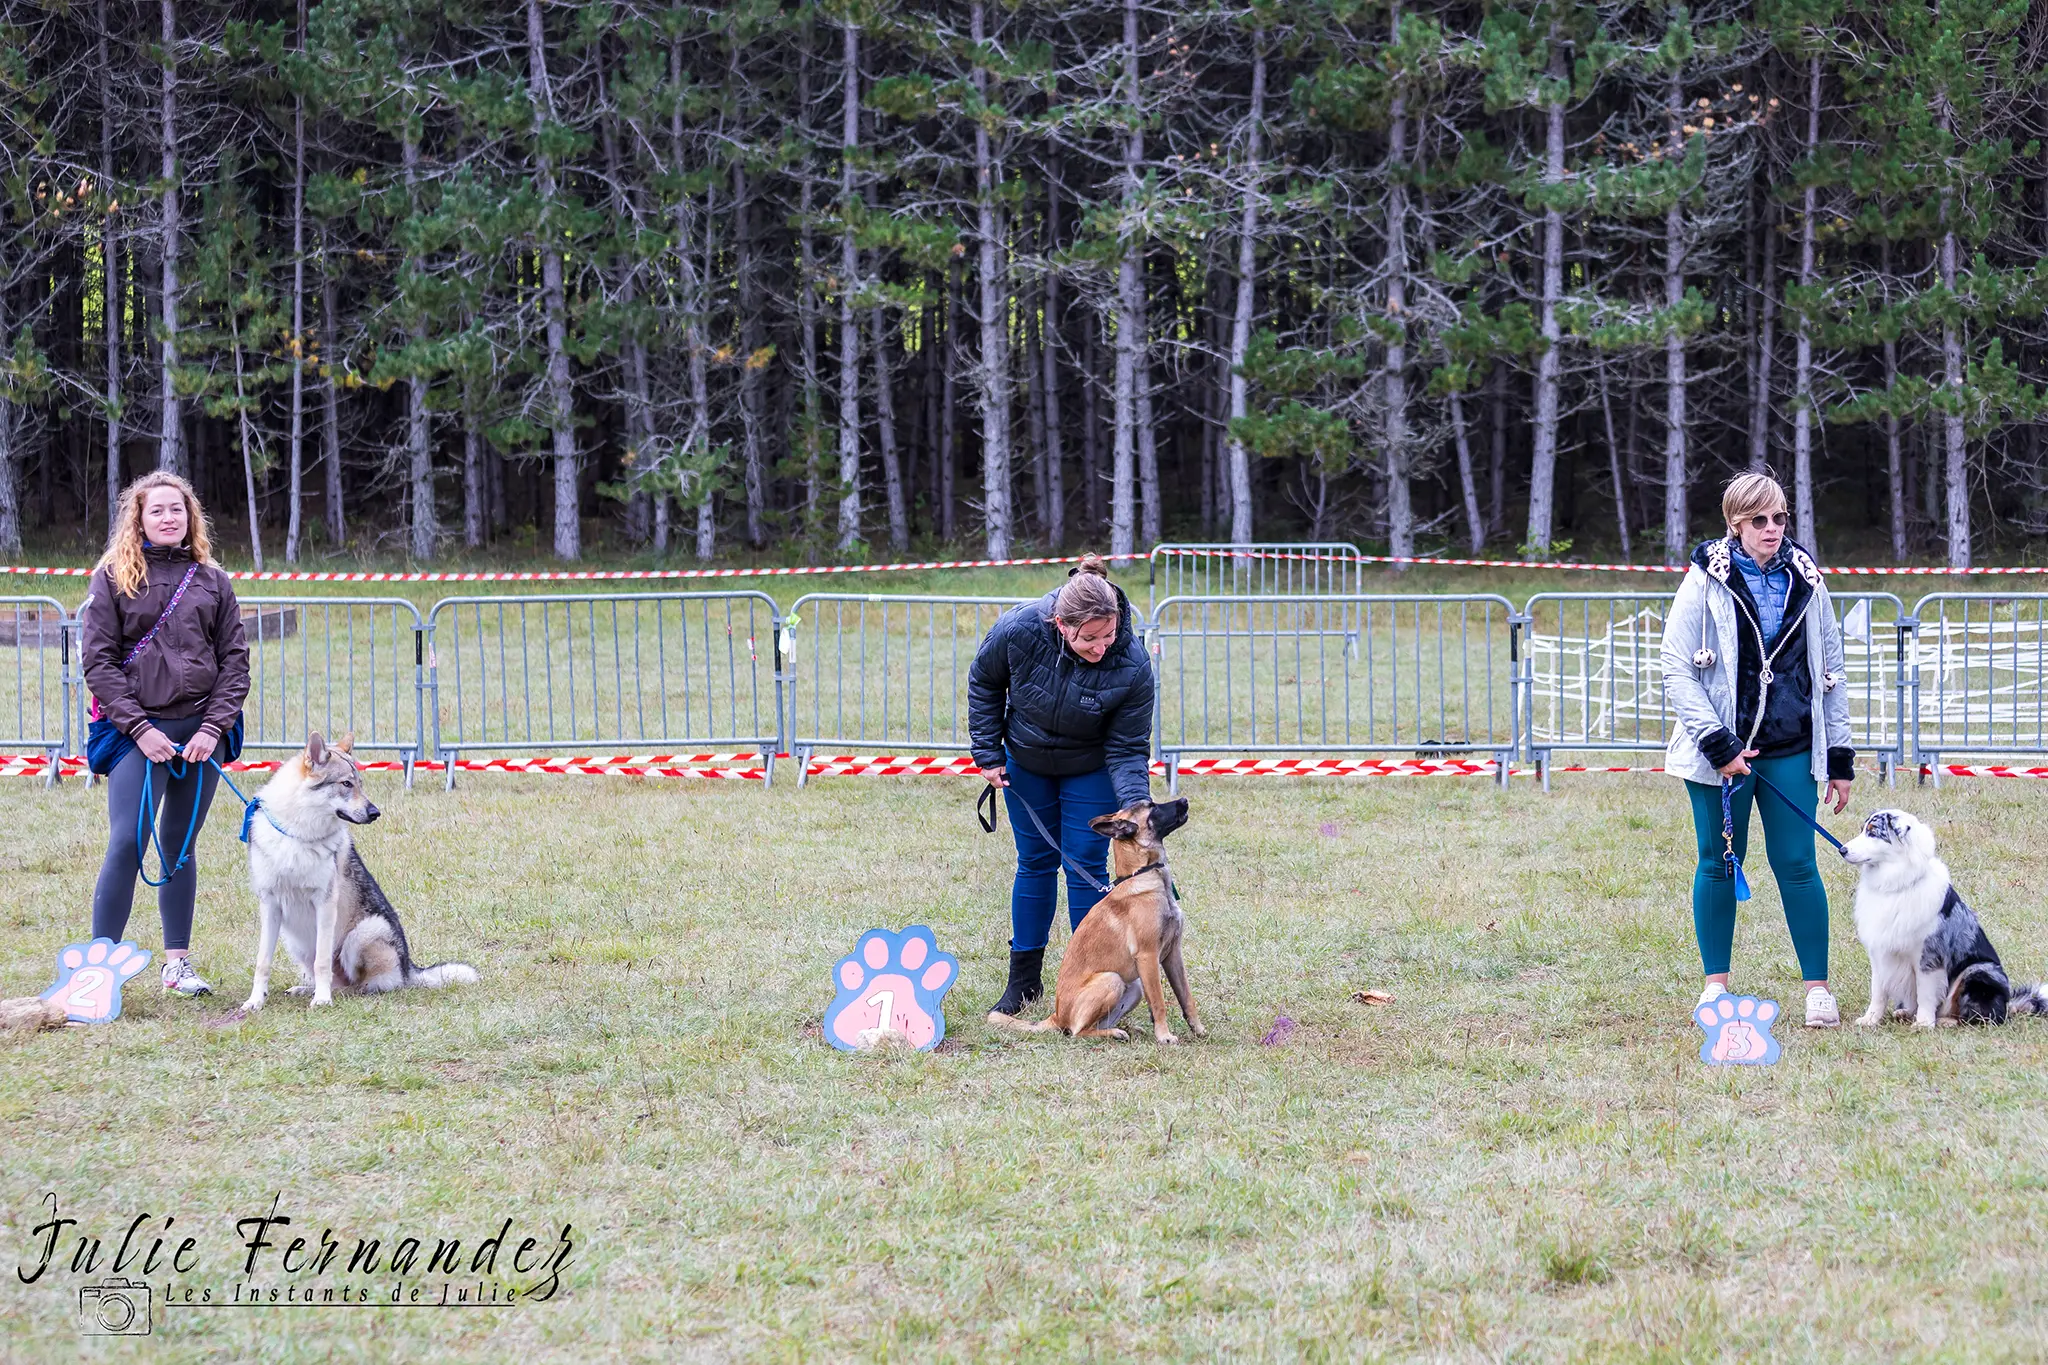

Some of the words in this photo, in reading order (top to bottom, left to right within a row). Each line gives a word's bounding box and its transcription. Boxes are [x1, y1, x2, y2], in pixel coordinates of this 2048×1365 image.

[66, 968, 105, 1008] 2
[865, 990, 897, 1031] 1
[1726, 1025, 1752, 1058] 3
